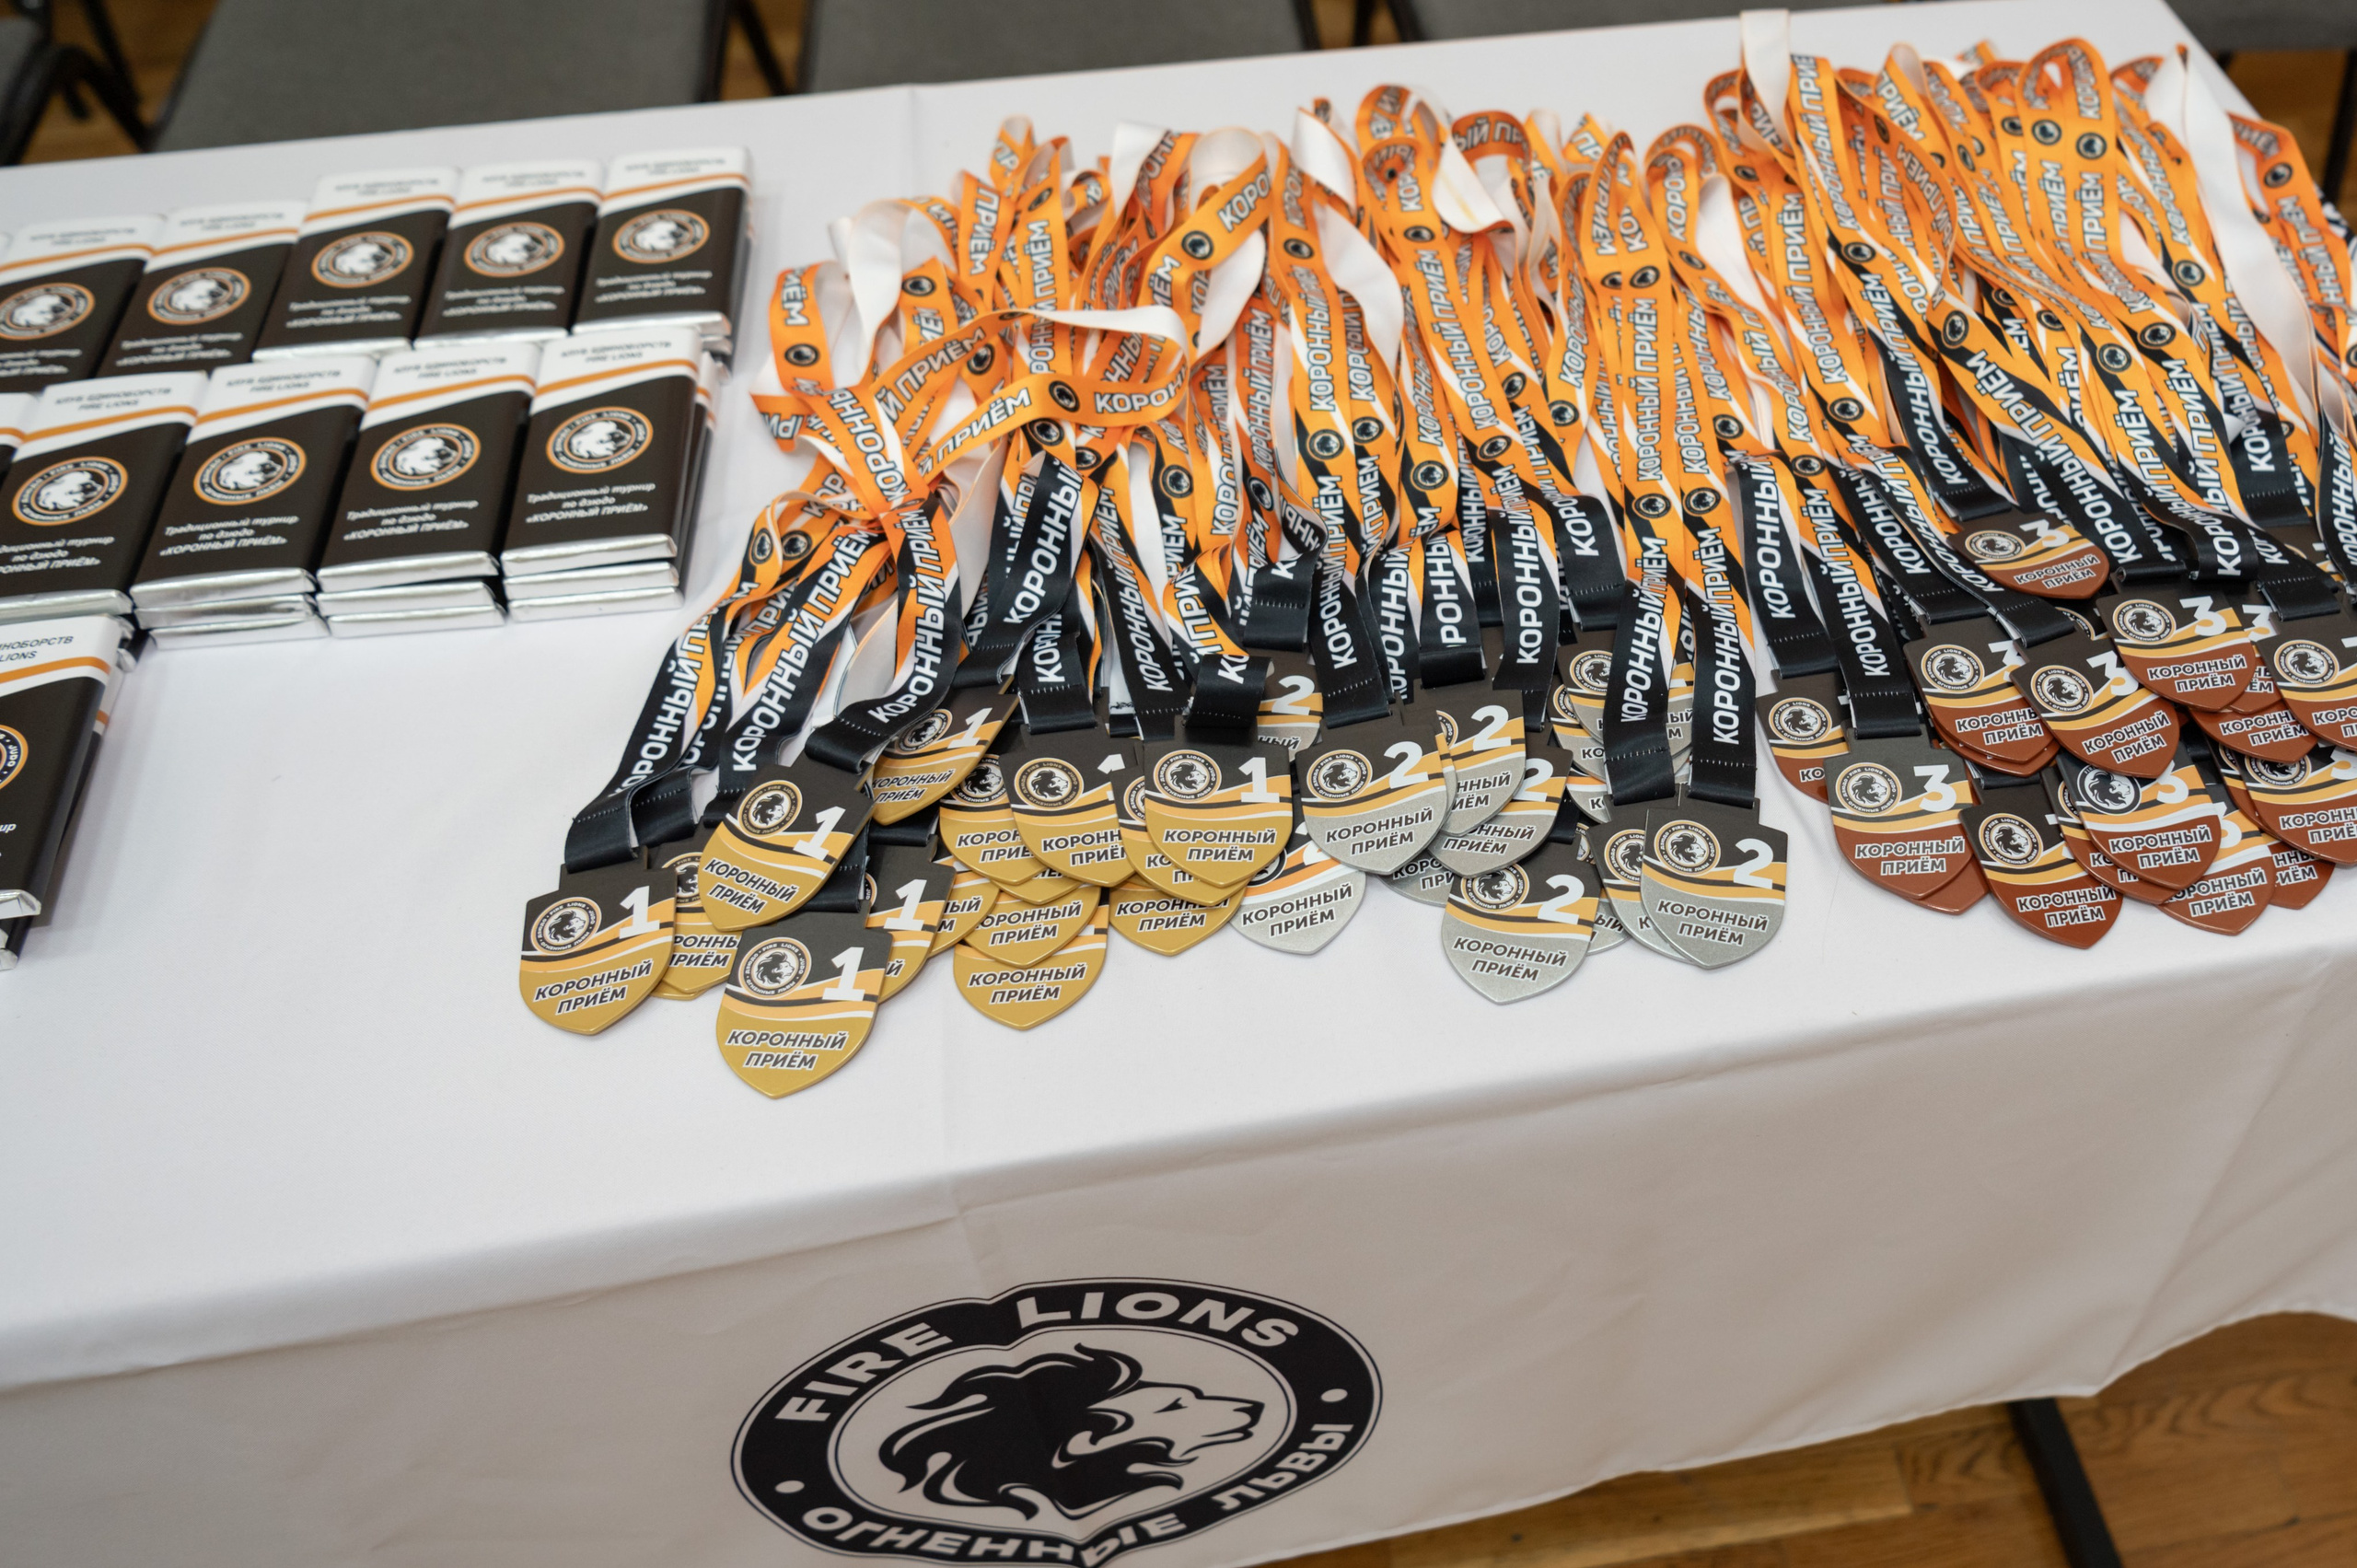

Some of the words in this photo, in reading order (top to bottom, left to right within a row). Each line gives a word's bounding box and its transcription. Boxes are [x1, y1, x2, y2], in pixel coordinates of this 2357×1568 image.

[969, 187, 1001, 275] ПРИЁМ
[2074, 171, 2108, 251] ПРИЁМ
[1024, 220, 1057, 298] ПРИЁМ
[1777, 192, 1815, 282] ПРИЁМ
[1414, 248, 1457, 319] ПРИЁМ
[1627, 296, 1659, 375] ПРИЁМ
[1858, 272, 1911, 354] ПРИЁМ
[895, 327, 987, 402] ПРИЁМ
[1432, 317, 1502, 431] КОРОННЫЙ
[1888, 350, 1968, 485] КОРОННЫЙ
[1965, 351, 2053, 440] ПРИЁМ
[2162, 359, 2216, 453] ПРИЁМ
[936, 387, 1032, 464] ПРИЁМ
[1629, 374, 1663, 482] КОРОННЫЙ
[2114, 389, 2170, 481] ПРИЁМ
[1312, 475, 1346, 553] ПРИЁМ
[2035, 433, 2143, 564] КОРОННЫЙ
[895, 508, 942, 580] ПРИЁМ
[1004, 459, 1085, 624] КОРОННЫЙ
[1741, 454, 1798, 620] КОРОННЫЙ
[1802, 487, 1851, 565] ПРИЁМ
[2018, 517, 2070, 549] 3
[1500, 506, 1543, 665] КОРОННЫЙ
[1692, 526, 1735, 605] ПРИЁМ
[2014, 553, 2100, 586] КОРОННЫЙ
[2042, 568, 2096, 591] ПРИЁМ
[1107, 554, 1174, 692] КОРОННЫЙ
[1819, 563, 1892, 678] КОРОННЫЙ
[2178, 595, 2227, 636] 3
[732, 608, 827, 772] КОРОННЫЙ
[811, 529, 880, 620] ПРИЁМ
[867, 574, 946, 724] КОРОННЫЙ
[1620, 587, 1667, 724] КОРОННЫЙ
[2147, 654, 2248, 681] КОРОННЫЙ
[1701, 600, 1741, 745] КОРОННЫЙ
[2175, 673, 2235, 694] ПРИЁМ
[1271, 675, 1315, 716] 2
[946, 706, 993, 749] 1
[1469, 704, 1512, 751] 2
[1983, 723, 2044, 746] ПРИЁМ
[2081, 711, 2172, 755] КОРОННЫЙ
[2111, 732, 2167, 764] ПРИЁМ
[1237, 757, 1280, 803] 1
[1383, 740, 1429, 790] 2
[1912, 763, 1957, 812] 3
[875, 788, 928, 804] ПРИЁМ
[792, 805, 847, 862] 1
[1041, 829, 1121, 853] КОРОНН
[1163, 826, 1278, 846] КОРОННЫЙ
[1325, 807, 1434, 844] КОРОННЫЙ
[1350, 830, 1415, 857] ПРИЁМ
[1442, 838, 1509, 855] ПРИЁМ
[1854, 835, 1966, 859] КОРОННЫЙ
[2107, 824, 2213, 854] КОРОННЫЙ
[1186, 845, 1256, 863] ПРИЁМ
[1732, 837, 1774, 889] 2
[1880, 857, 1946, 877] ПРИЁМ
[2138, 848, 2200, 870] ПРИЁМ
[702, 857, 800, 903] КОРОННЫЙ
[707, 883, 767, 915] ПРИЁМ
[1537, 874, 1585, 925] 2
[2016, 885, 2117, 913] КОРОННЫЙ
[2169, 866, 2269, 901] ОРОННЫЙ
[619, 885, 660, 940] 1
[884, 878, 927, 931] 1
[977, 900, 1083, 931] ОРОННЫЙ
[1137, 912, 1206, 933] ПРИЁМ
[1241, 883, 1353, 927] КОРОННЫЙ
[1269, 907, 1336, 938] ПРИЁМ
[1655, 900, 1770, 933] КОРОННЫЙ
[2044, 907, 2106, 929] ПРИЁМ
[2189, 892, 2255, 918] ПРИЁМ
[989, 923, 1058, 947] ПРИЁМ
[1453, 935, 1568, 969] КОРОННЫЙ
[1677, 922, 1747, 947] ПРИЁМ
[532, 958, 654, 1003] КОРОННЫЙ
[821, 946, 865, 1002] 1
[968, 963, 1089, 988] КОРОННЫЙ
[1470, 958, 1540, 983] ПРИЁМ
[555, 986, 628, 1016] ПРИЁМ
[989, 986, 1061, 1005] ПРИЁМ
[725, 1028, 850, 1051] КОРОННЫЙ
[742, 1052, 819, 1071] ПРИЁМ
[774, 1322, 953, 1423] FIRE
[1016, 1292, 1299, 1348] LIONS
[802, 1506, 1188, 1568] ОГНЕННЫЕ
[1212, 1423, 1354, 1509] ЛЬВЫ
